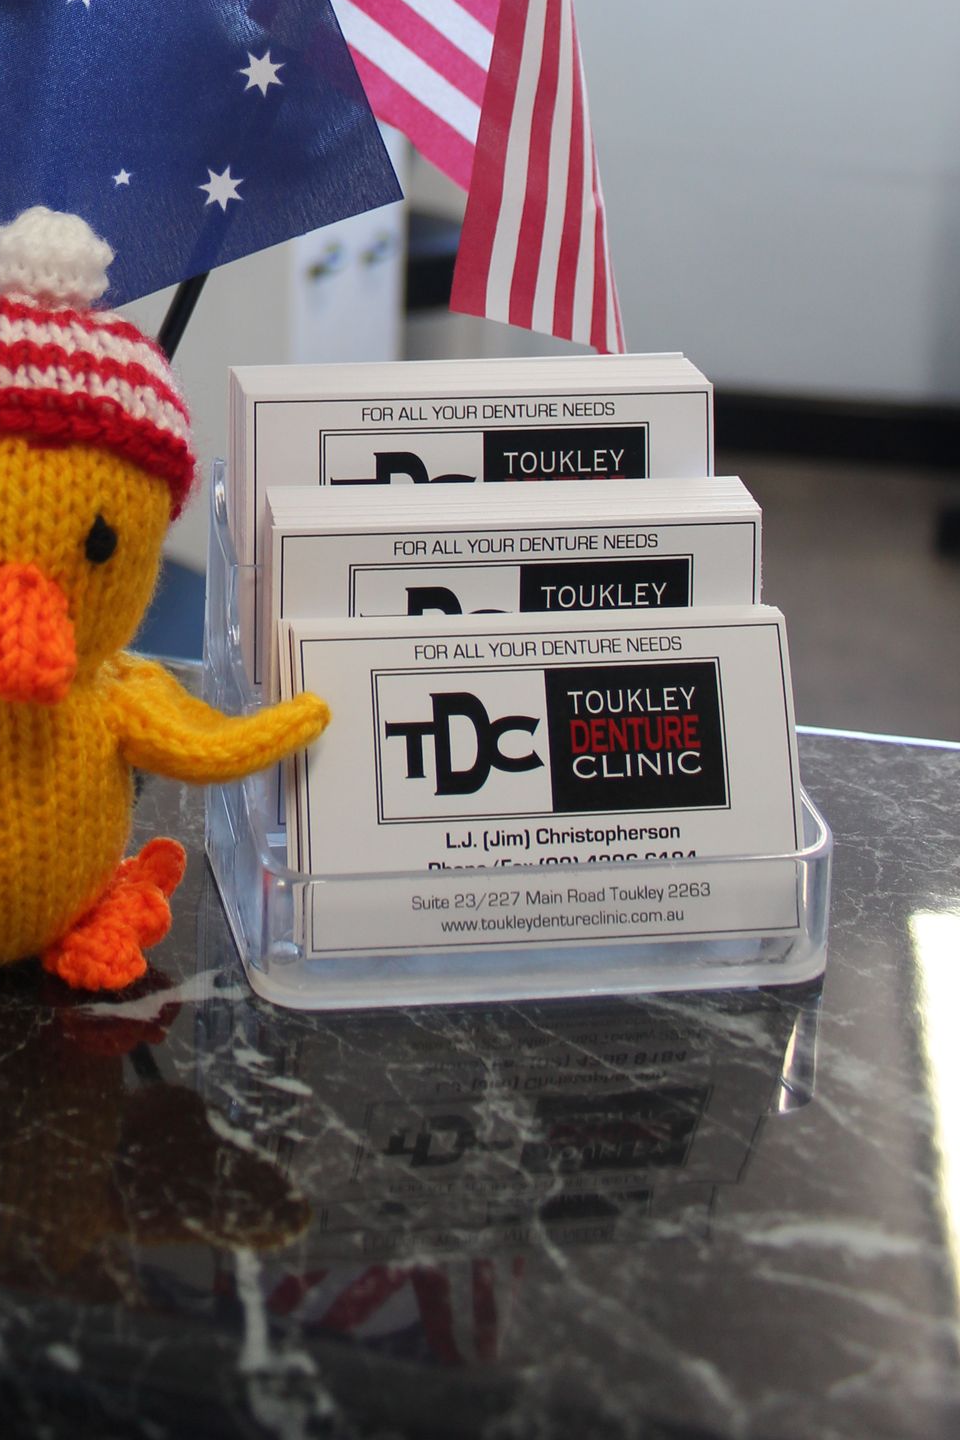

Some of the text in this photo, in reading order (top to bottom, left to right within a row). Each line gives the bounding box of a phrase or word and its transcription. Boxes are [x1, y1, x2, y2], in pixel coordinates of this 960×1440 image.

[361, 401, 616, 422] FOR ALL YOUR DENTURE NEEDS
[503, 448, 625, 474] TOUKLEY
[393, 533, 659, 556] FOR ALL YOUR DENTURE NEEDS
[540, 582, 668, 608] TOUKLEY
[414, 635, 683, 661] FOR ALL YOUR DENTURE NEEDS
[567, 686, 695, 715] TOUKLEY
[384, 691, 545, 796] TDC
[571, 714, 701, 753] DENTURE
[572, 750, 702, 779] CLINIC
[445, 824, 681, 852] L.J. (Jim) Christopherson
[411, 881, 711, 912] Suite 23/227 Main Road Toukley 2263
[441, 909, 685, 933] www.toukleydentureclinic.com.au
